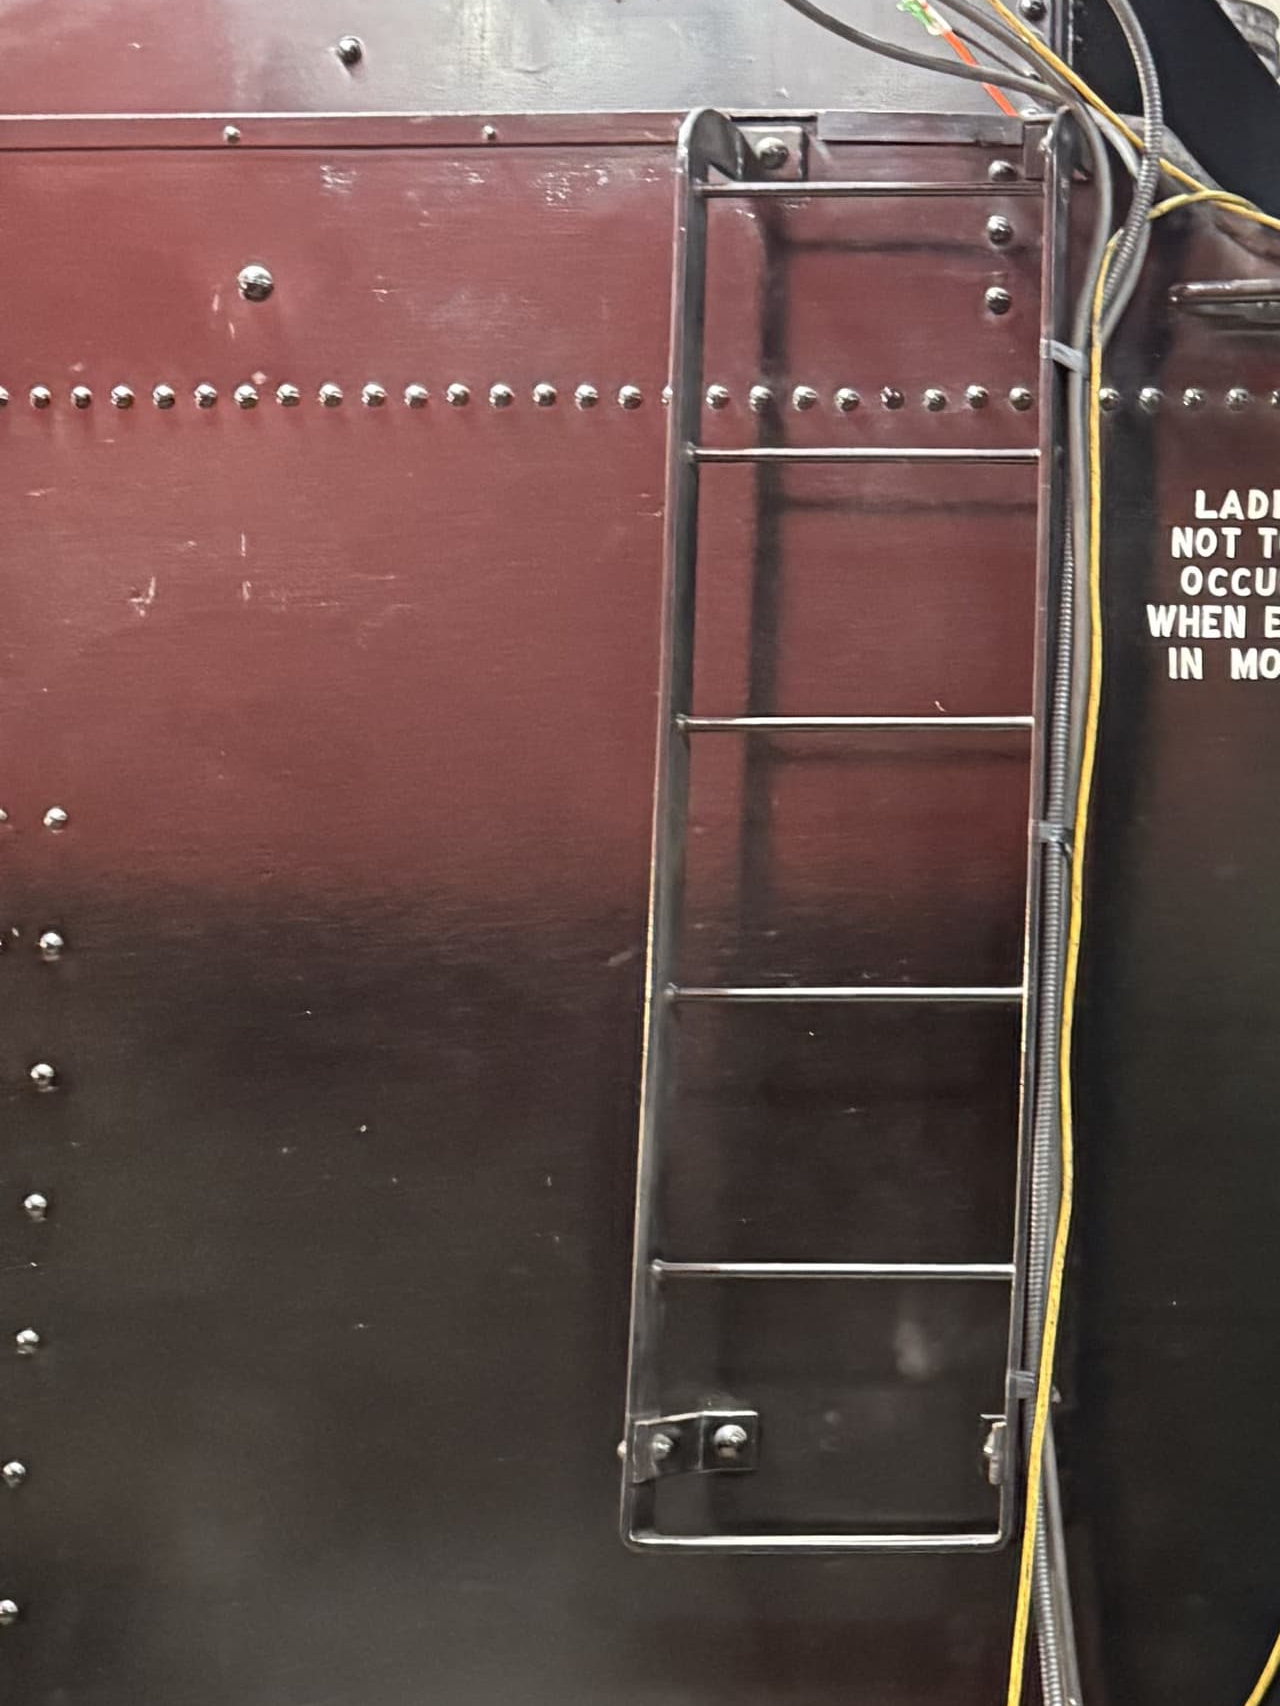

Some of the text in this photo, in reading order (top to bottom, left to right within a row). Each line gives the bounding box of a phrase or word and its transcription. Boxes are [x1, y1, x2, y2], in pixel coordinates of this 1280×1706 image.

[1171, 526, 1242, 559] NOT
[1146, 603, 1247, 639] WHEN
[1168, 646, 1203, 680] IN
